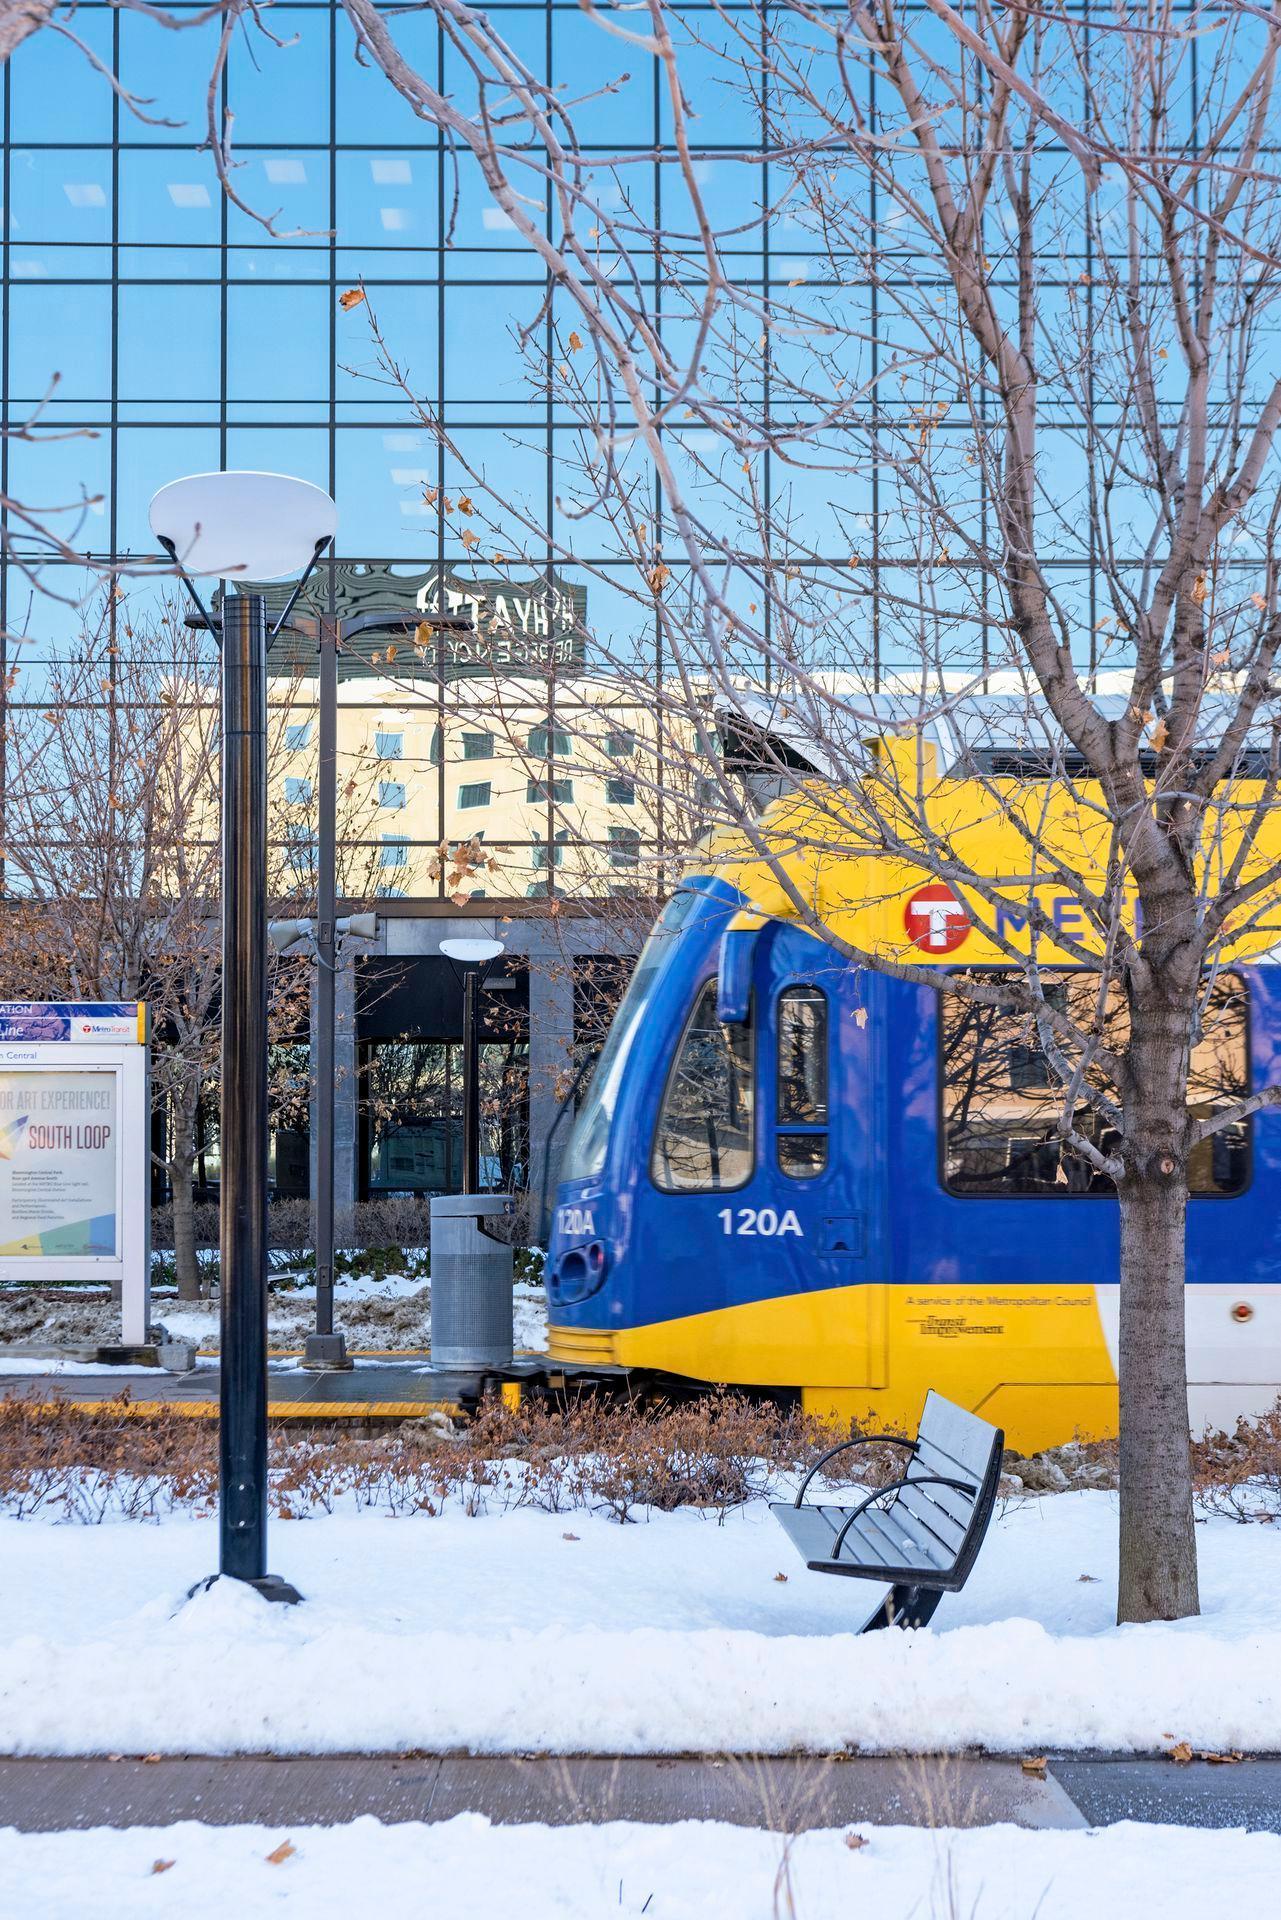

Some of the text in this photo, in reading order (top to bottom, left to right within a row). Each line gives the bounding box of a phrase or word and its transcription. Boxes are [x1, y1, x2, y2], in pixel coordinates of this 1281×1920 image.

[7, 1051, 37, 1059] Central
[17, 1090, 38, 1110] ART
[41, 1090, 111, 1110] EXPERIENCE!
[29, 1125, 111, 1149] SOUTH LOOP
[557, 1208, 596, 1236] 120A
[718, 1208, 804, 1236] 120A
[905, 1296, 1092, 1308] A service of the Metropolitan Council
